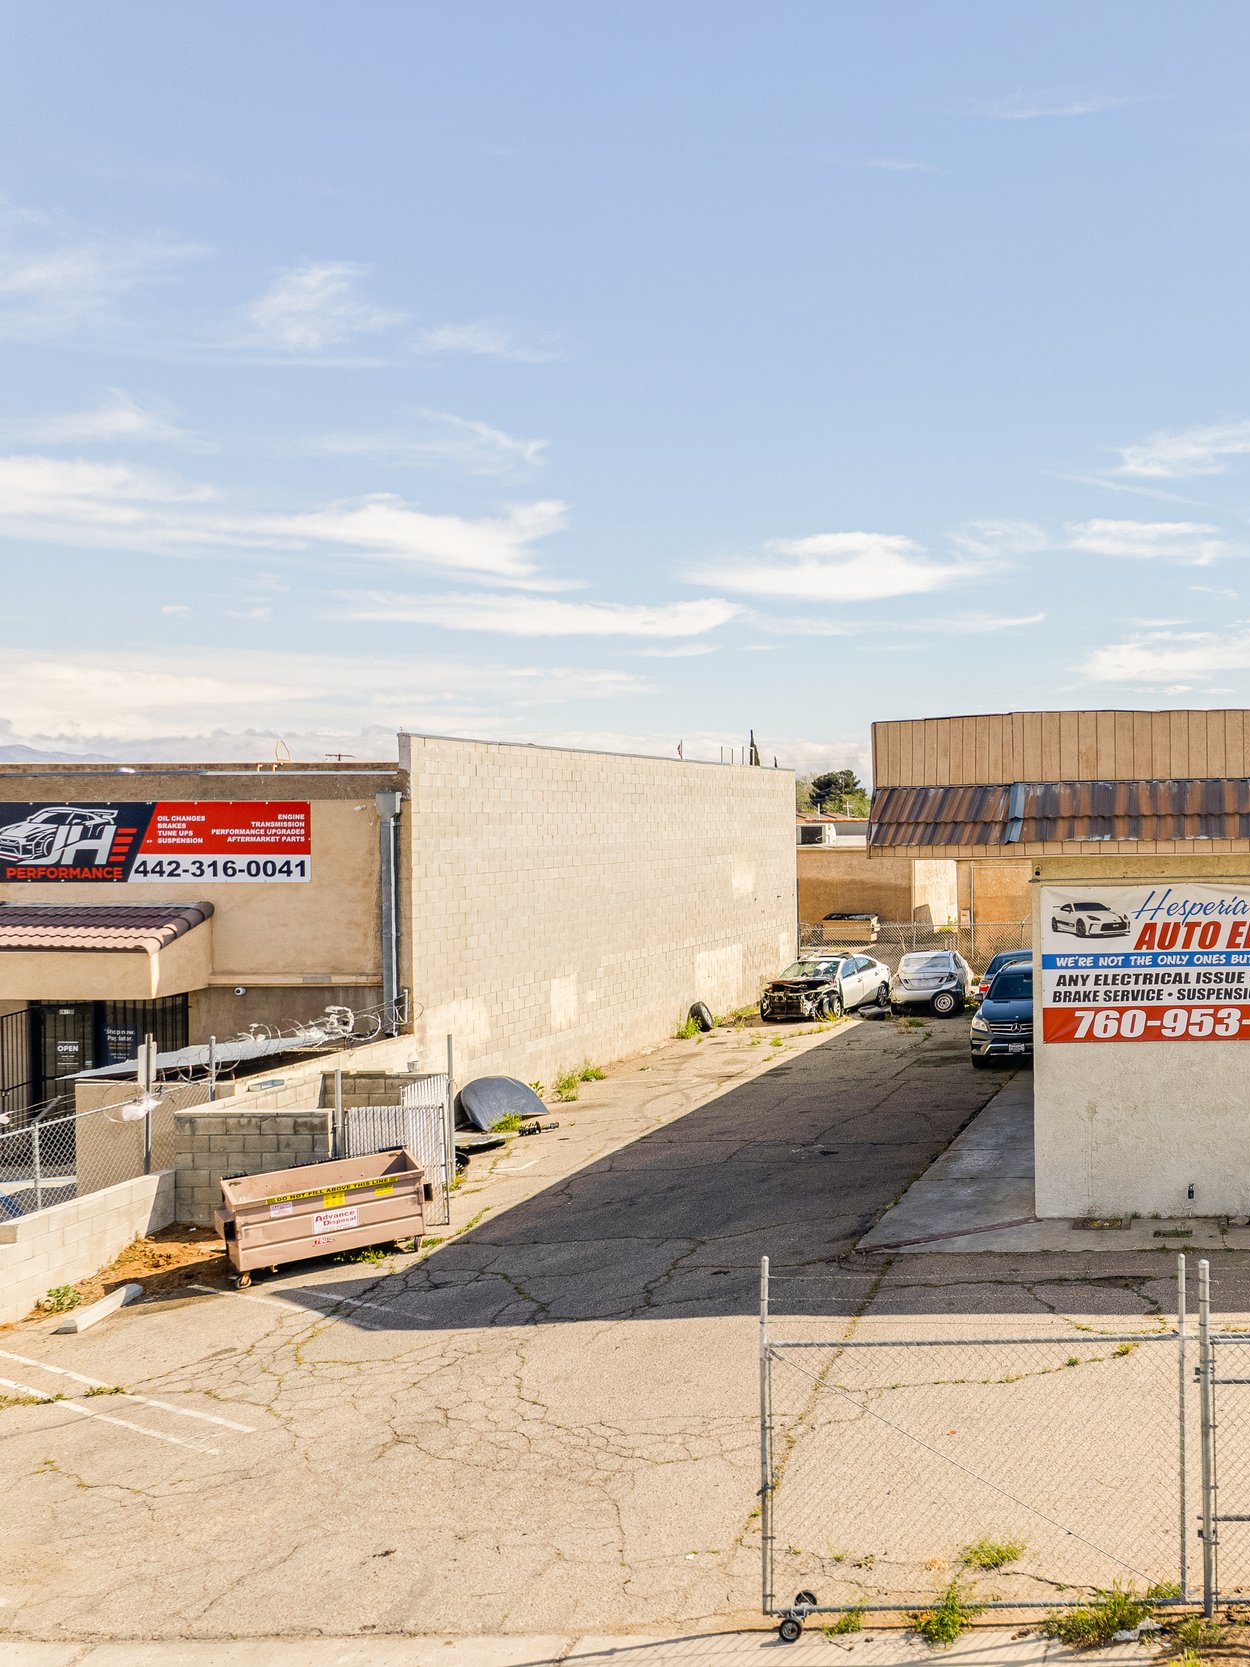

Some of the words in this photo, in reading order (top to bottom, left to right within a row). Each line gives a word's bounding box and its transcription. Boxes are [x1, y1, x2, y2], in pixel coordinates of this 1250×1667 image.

[6, 867, 123, 879] PERFORMANCE
[134, 860, 306, 878] 442-316-0041
[1133, 920, 1222, 950] AUTO
[1056, 956, 1094, 967] WE'RE
[1099, 956, 1125, 967] NOT
[1129, 955, 1153, 965] THE
[1157, 955, 1189, 965] ONLY
[1193, 954, 1226, 964] ONES
[1055, 974, 1090, 987] ANY
[1093, 972, 1191, 986] ELECTRICAL
[1196, 971, 1246, 984] ISSUE
[1052, 990, 1100, 1003] BRAKE
[1102, 988, 1164, 1002] SERVICE
[315, 1210, 355, 1222] Advance
[323, 1215, 357, 1226] Disposal
